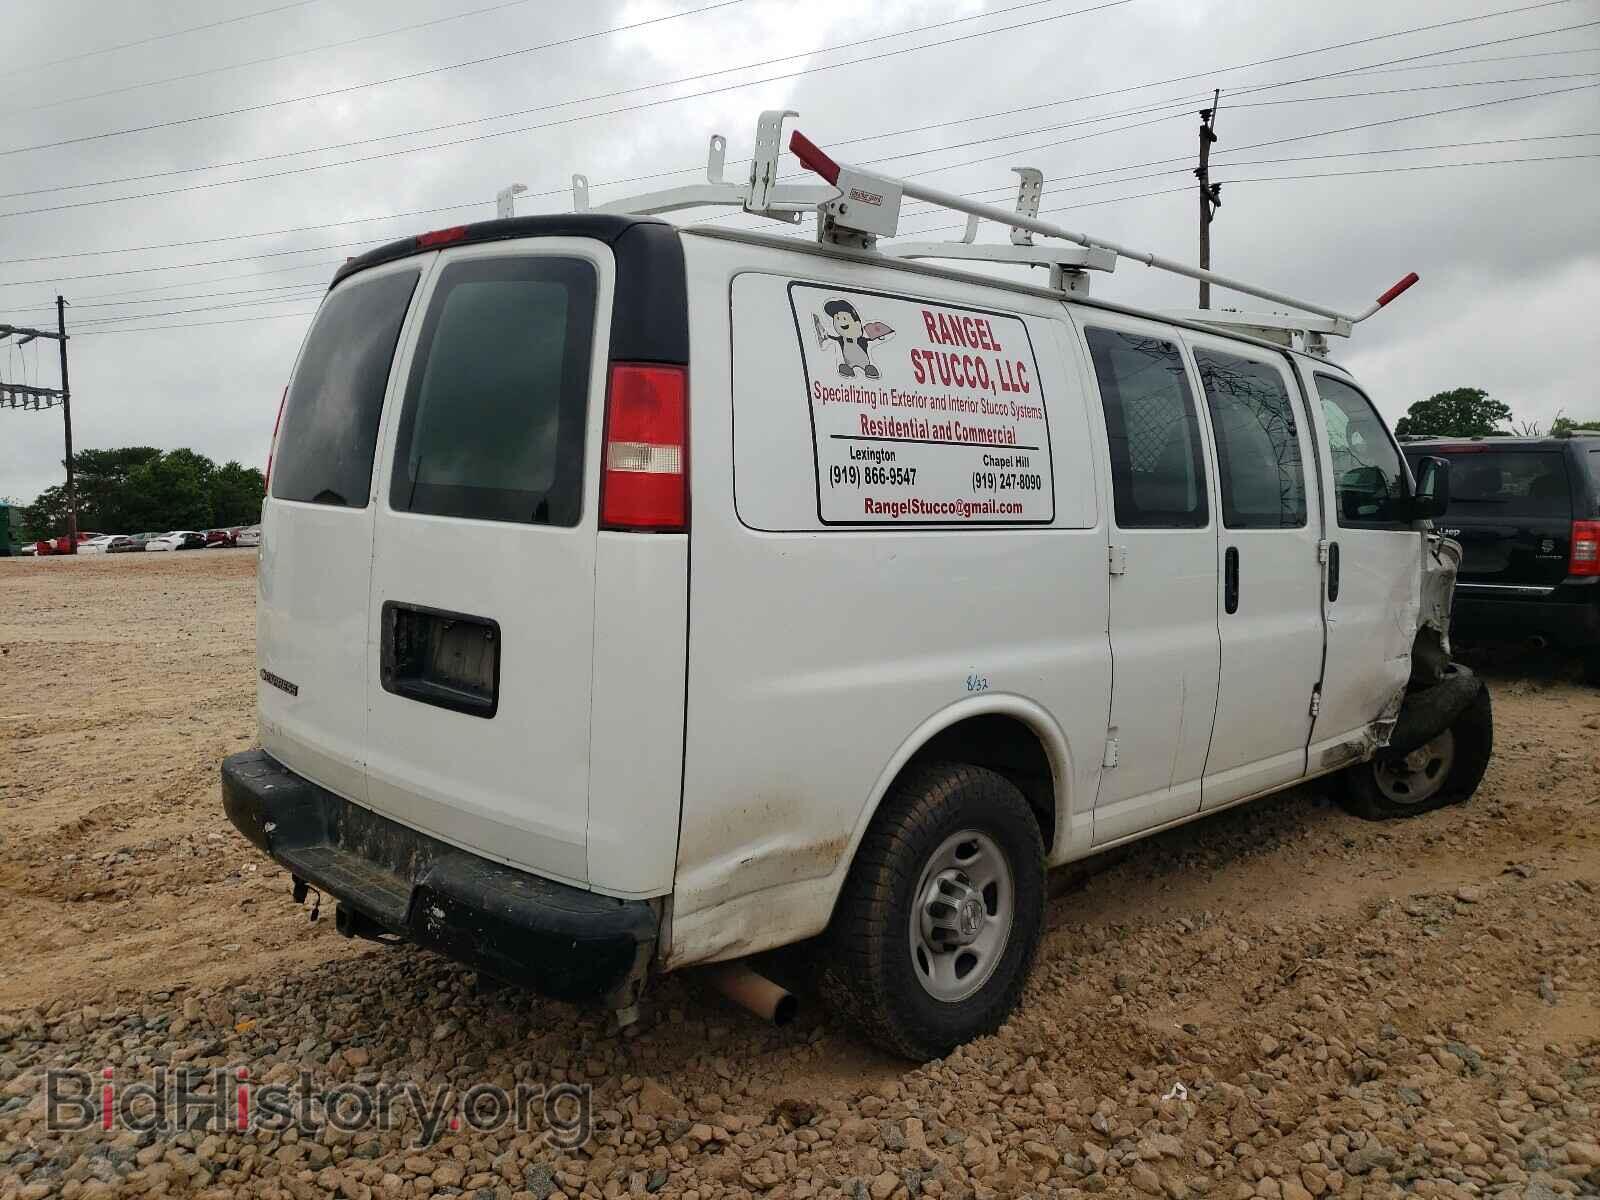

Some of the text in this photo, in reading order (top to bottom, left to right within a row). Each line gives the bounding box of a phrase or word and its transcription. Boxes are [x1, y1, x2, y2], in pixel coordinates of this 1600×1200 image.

[922, 311, 1001, 351] RANGEL
[911, 348, 1030, 395] STUCCO, LLC
[814, 381, 1042, 421] Specializing in Exterior and Interior Stucco Systems
[860, 414, 1016, 444] Residential and Commercial
[850, 446, 896, 465] Lexington
[983, 454, 1030, 470] Chapel Hill
[829, 465, 916, 489] (919) 866-9547
[972, 472, 1041, 492] (919) 247-8090
[864, 497, 1023, 518] RangelStucco@gmail.com
